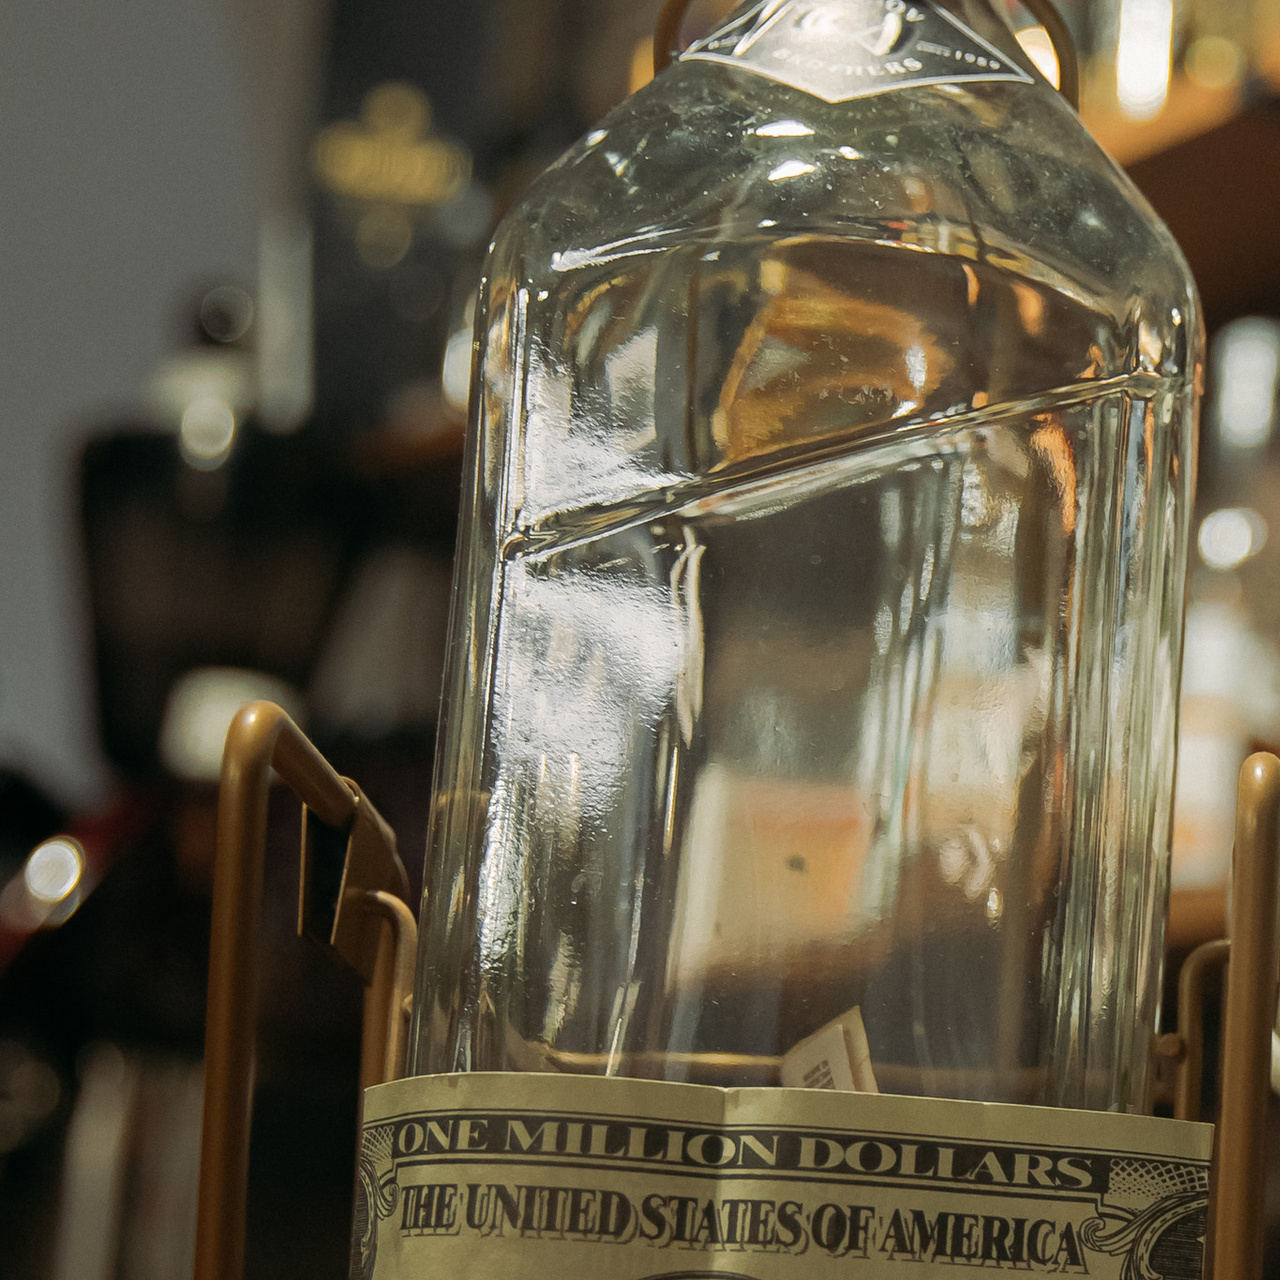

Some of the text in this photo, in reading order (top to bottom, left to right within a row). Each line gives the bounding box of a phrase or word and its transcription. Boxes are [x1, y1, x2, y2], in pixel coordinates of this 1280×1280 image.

[398, 1118, 1093, 1189] ONE MILLION DOLLARS
[400, 1183, 1091, 1276] THE UNITED STATES OF AMERICA
